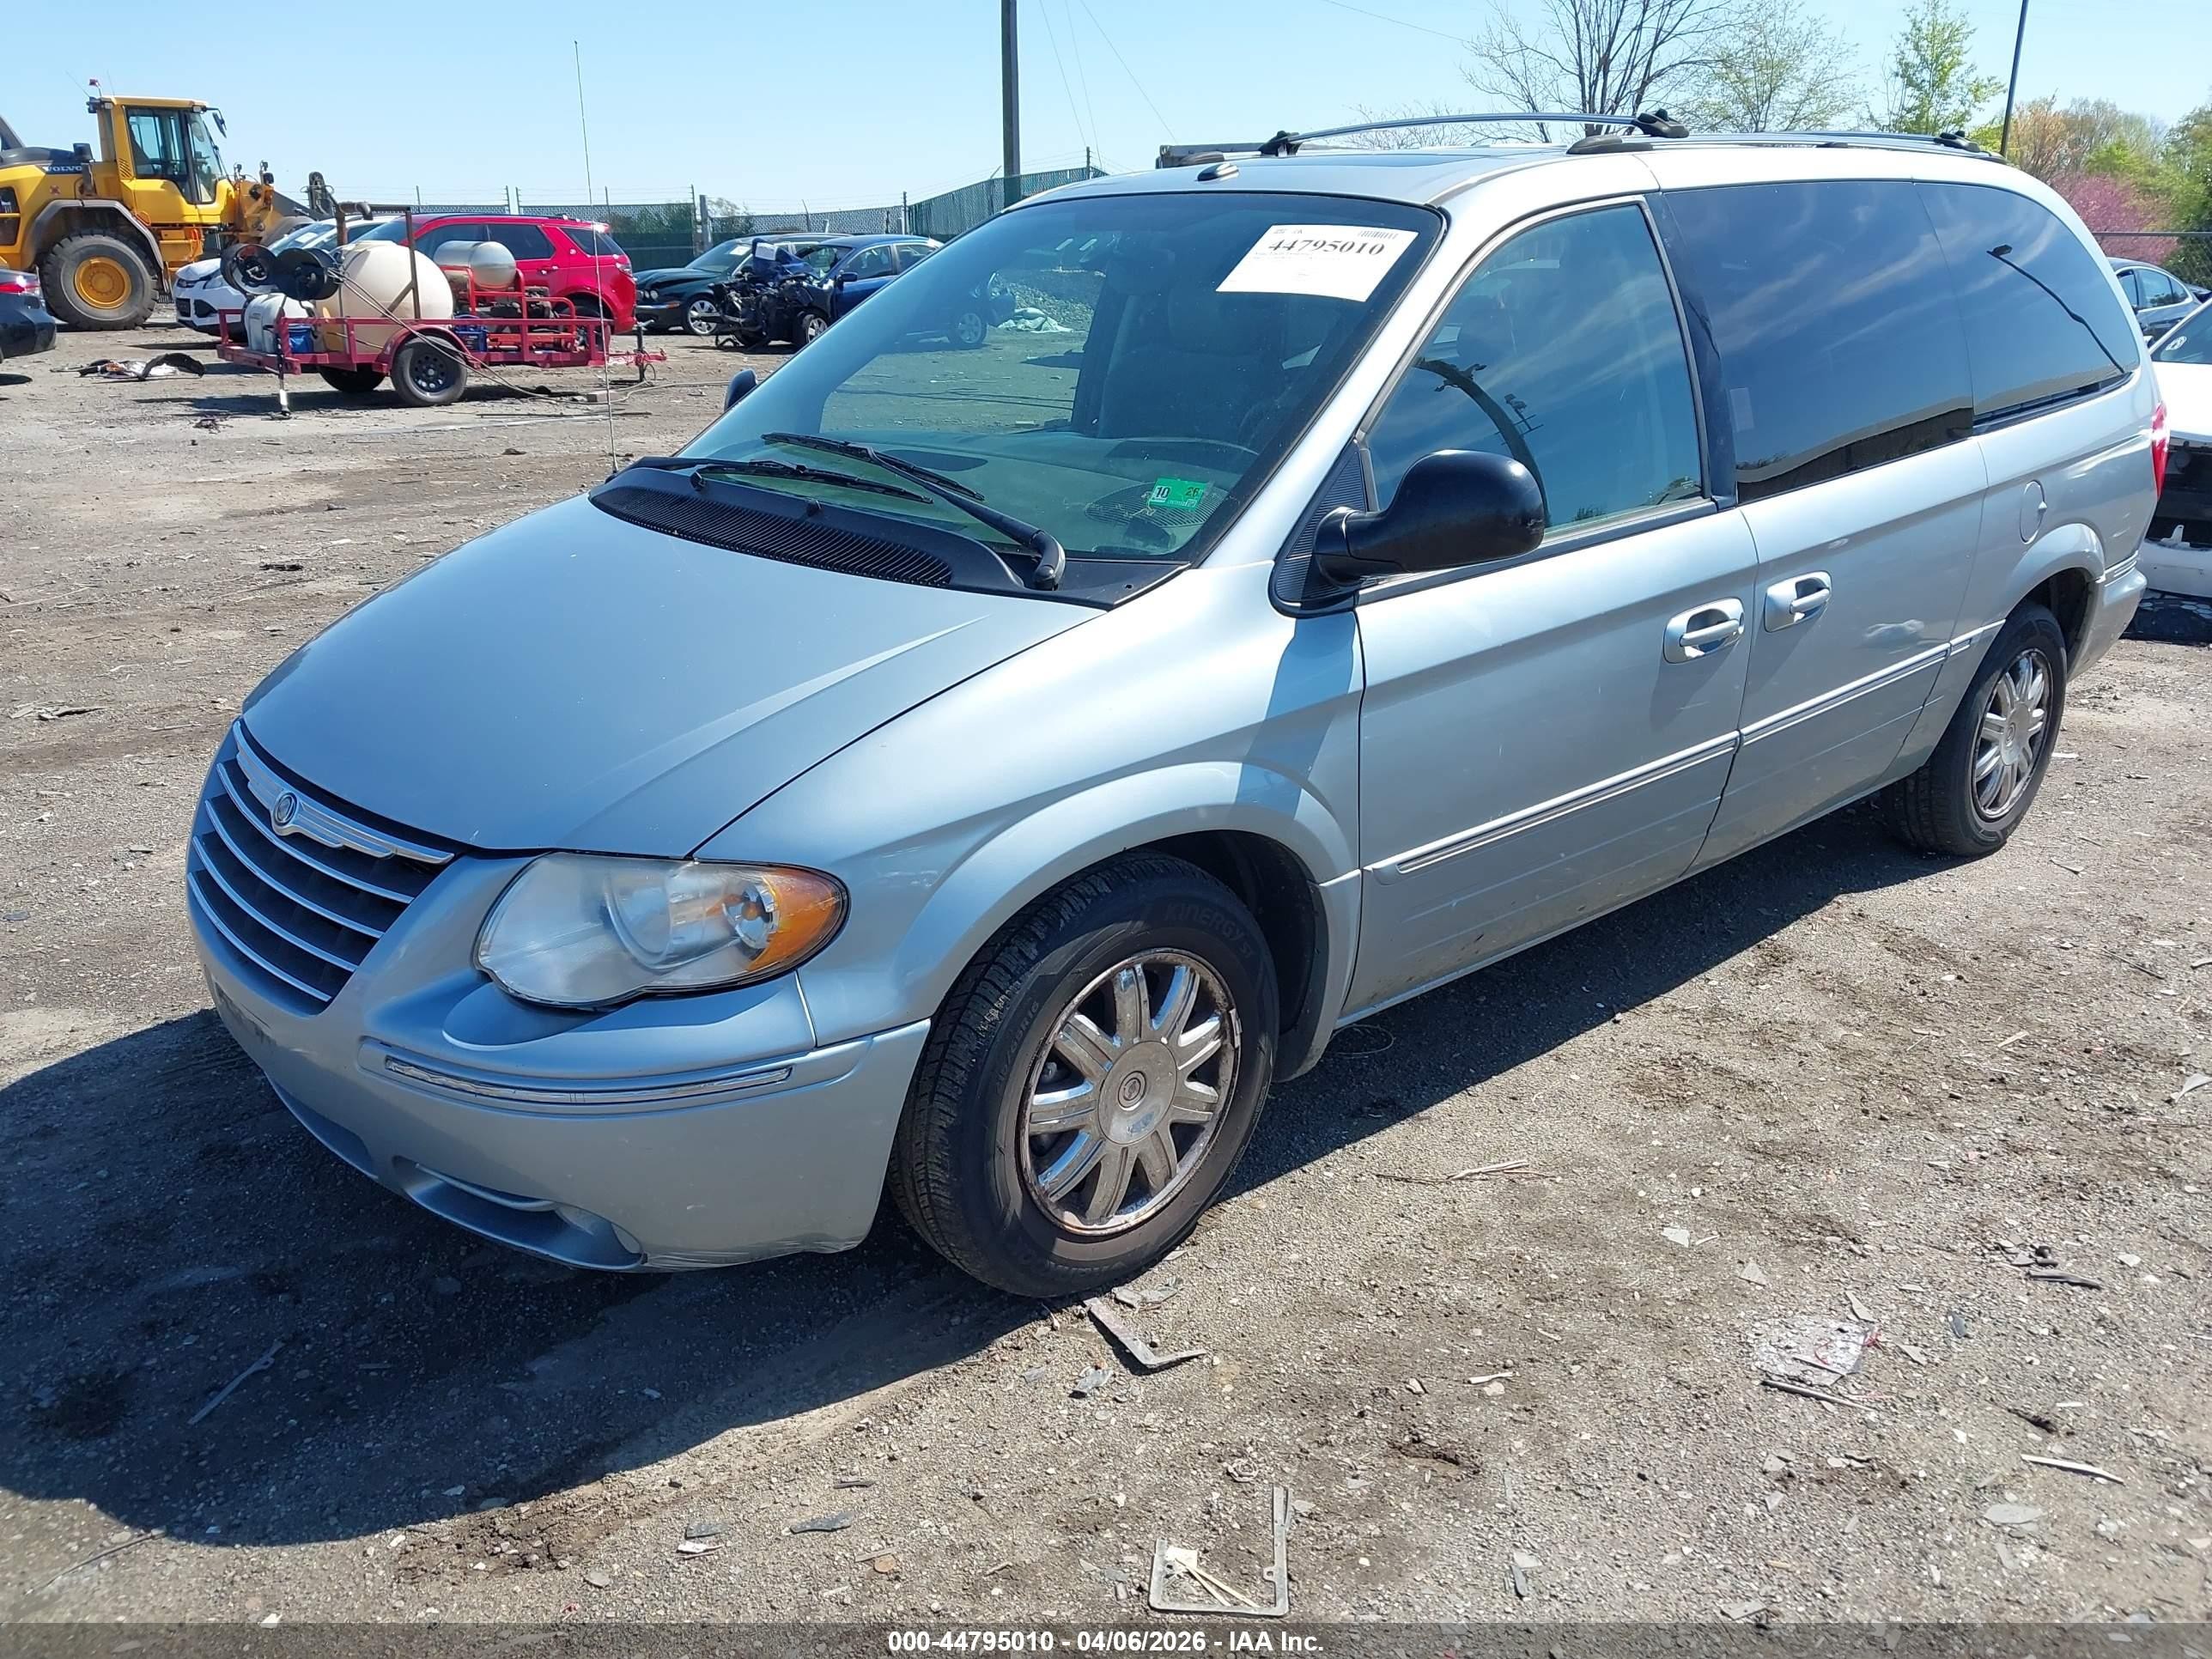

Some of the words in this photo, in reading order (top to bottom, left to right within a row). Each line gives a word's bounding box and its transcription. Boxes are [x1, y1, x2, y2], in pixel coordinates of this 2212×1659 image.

[1269, 239, 1385, 256] 44795010
[1156, 486, 1170, 498] 10
[1186, 486, 1200, 497] 26
